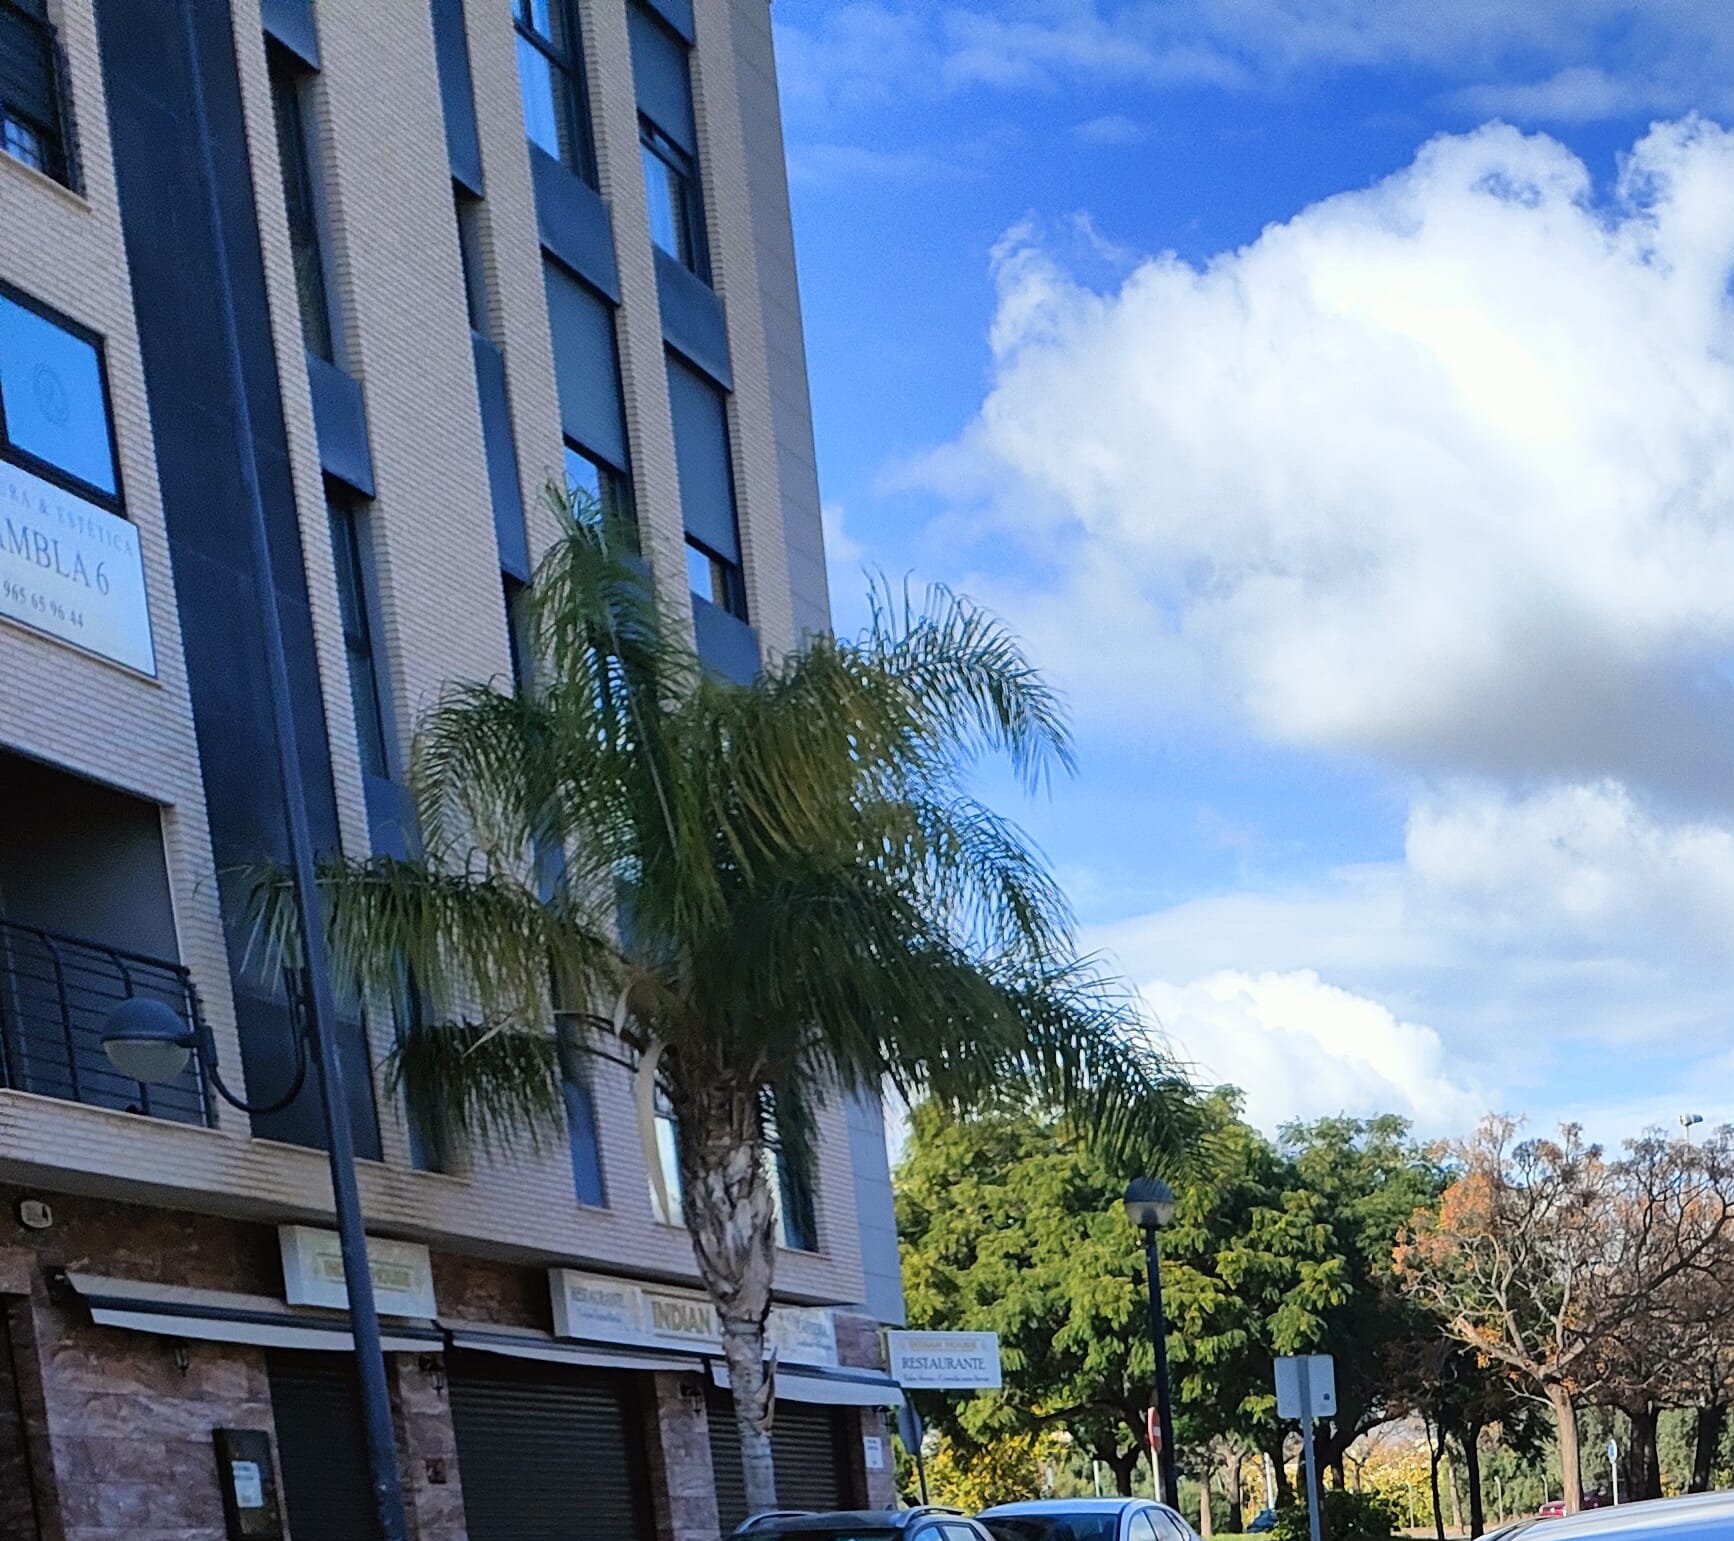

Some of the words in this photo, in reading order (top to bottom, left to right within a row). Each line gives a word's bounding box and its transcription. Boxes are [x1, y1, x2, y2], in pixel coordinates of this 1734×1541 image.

[96, 561, 109, 596] 6
[652, 1300, 711, 1335] INDIAN
[902, 1356, 985, 1370] RESTAURANTE
